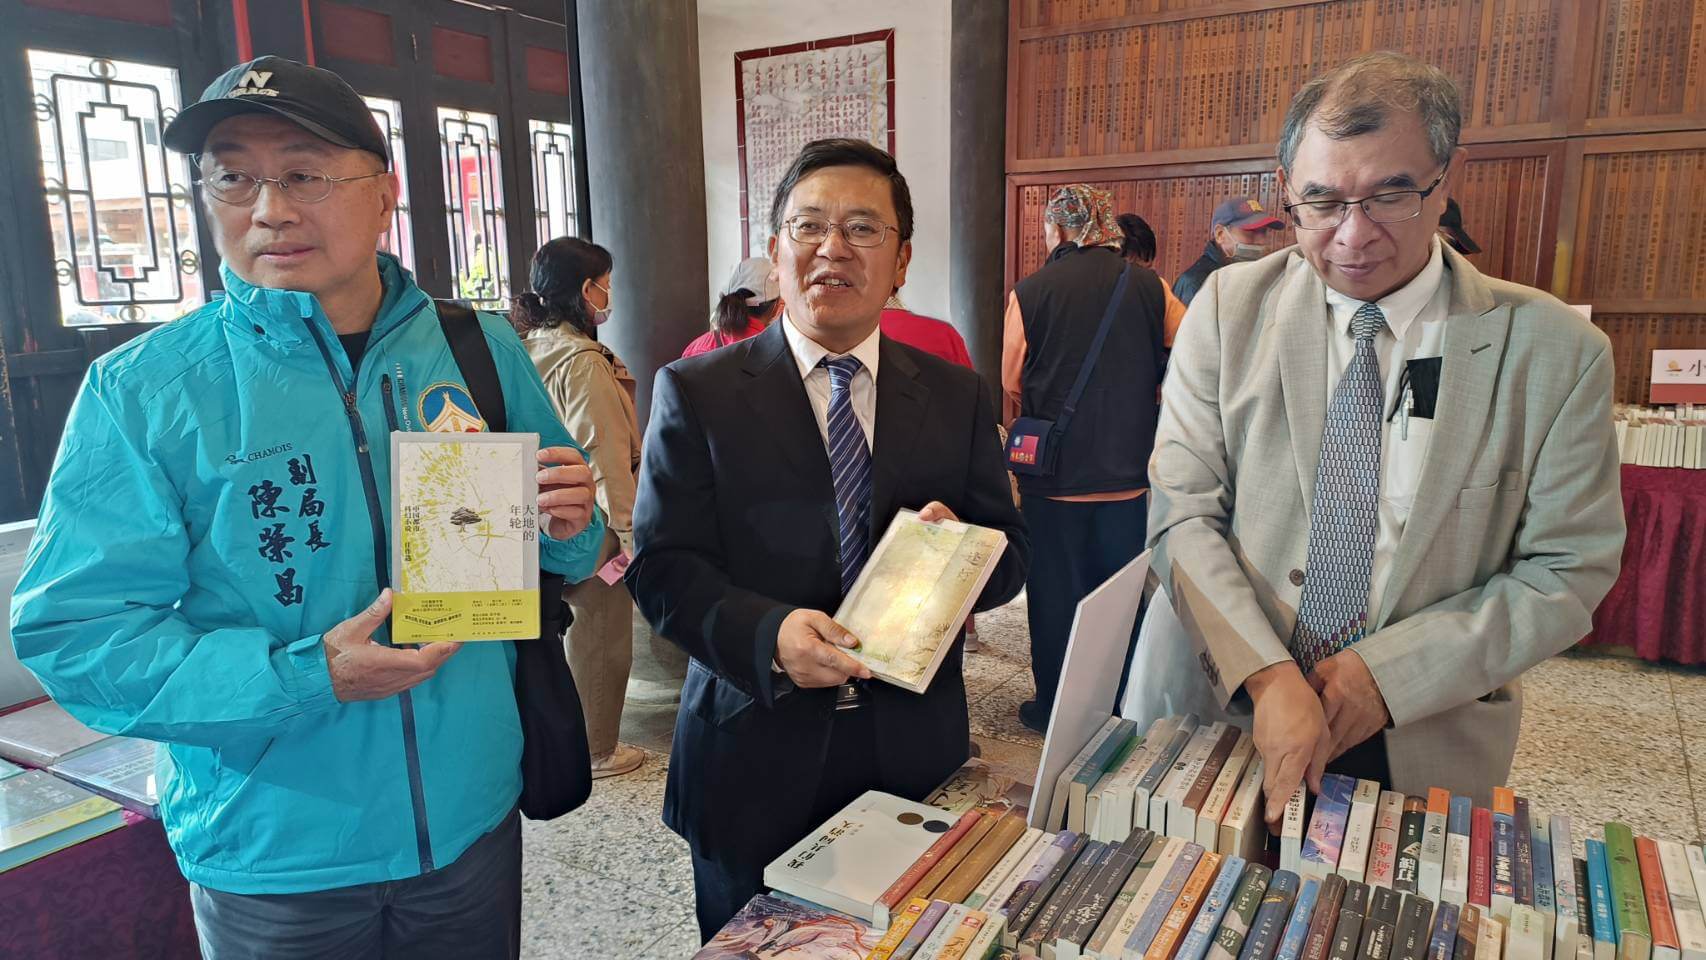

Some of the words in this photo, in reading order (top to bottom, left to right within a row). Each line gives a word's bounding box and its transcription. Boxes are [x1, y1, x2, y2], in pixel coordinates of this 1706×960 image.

[238, 70, 273, 89] N
[247, 442, 293, 462] CHAMOIS
[286, 453, 332, 553] 副局長
[509, 503, 522, 530] 年轮
[522, 504, 535, 542] 大地的
[247, 479, 304, 608] 陳榮昌
